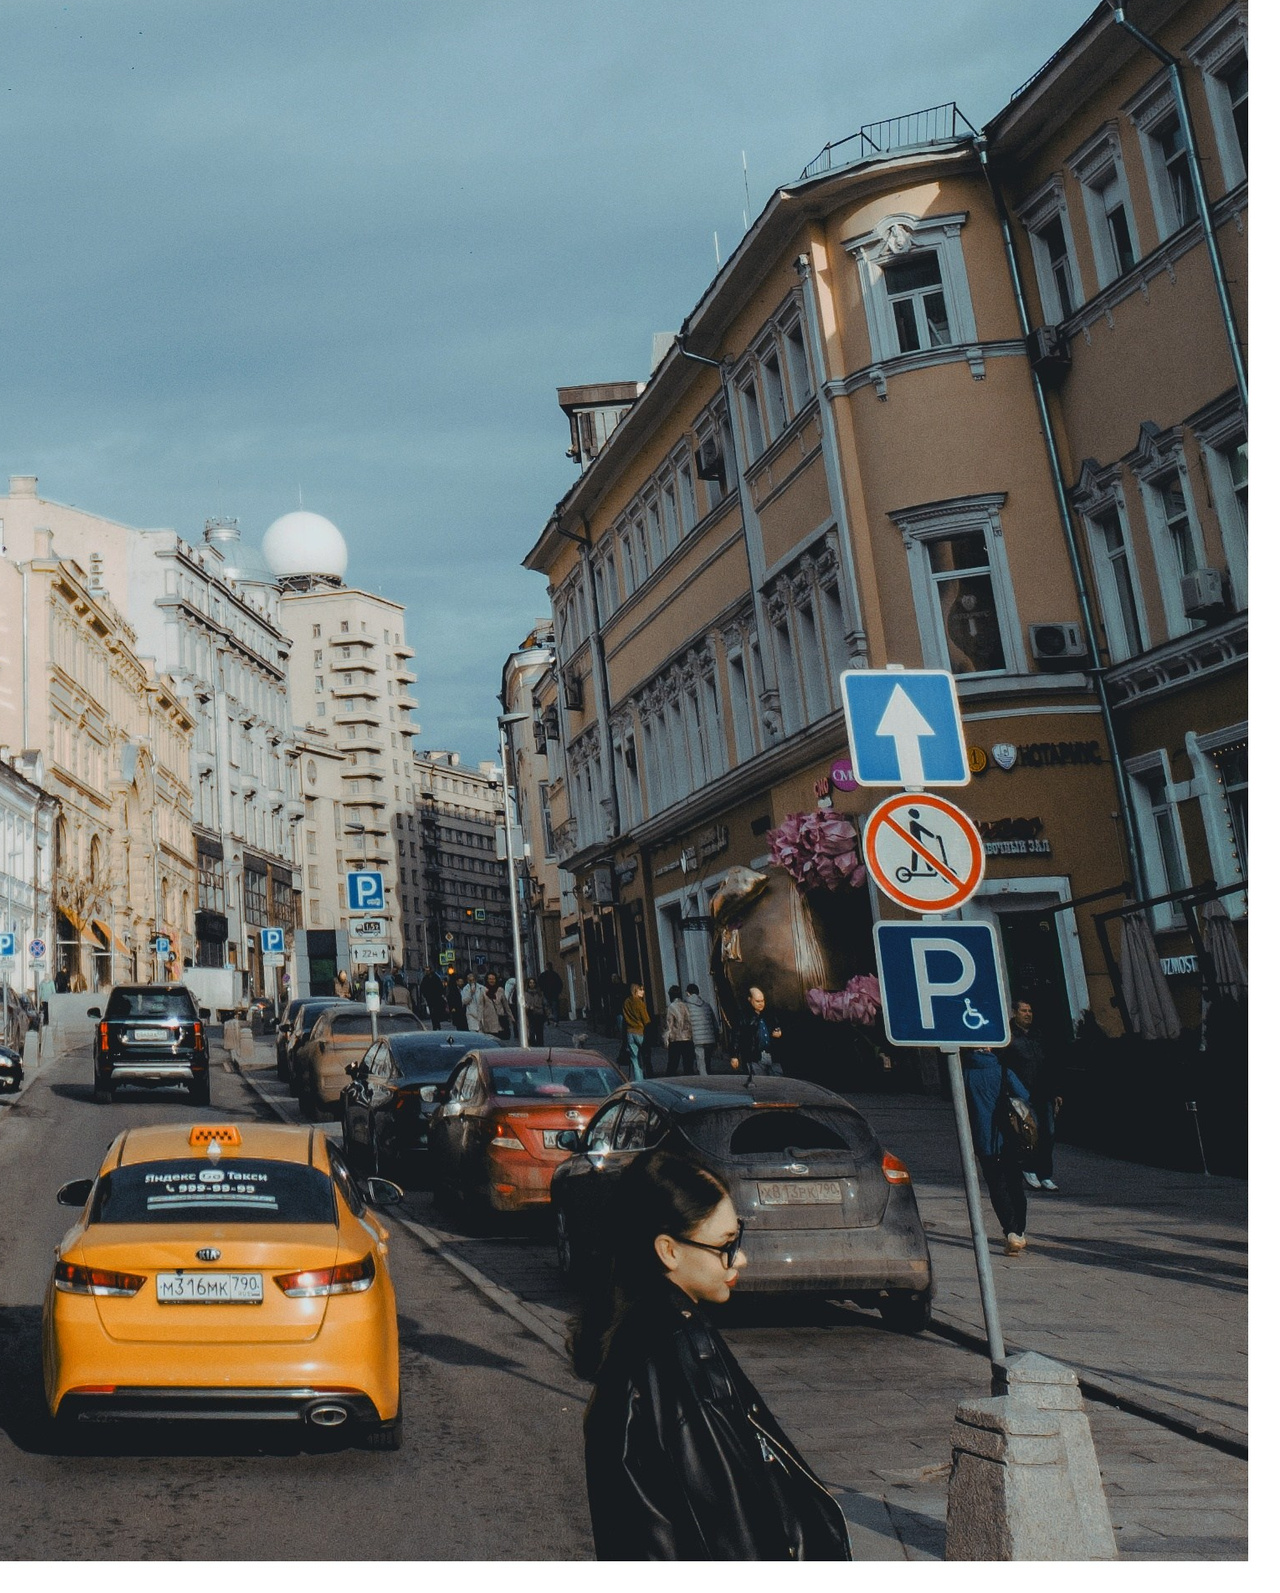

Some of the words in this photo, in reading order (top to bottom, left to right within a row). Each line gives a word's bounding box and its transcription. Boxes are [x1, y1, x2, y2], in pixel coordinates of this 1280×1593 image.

[985, 840, 1027, 855] ВОЧНЫЙ
[1028, 839, 1050, 853] ЗАЛ
[356, 875, 377, 907] P
[159, 940, 168, 951] P
[267, 931, 280, 950] P
[910, 938, 976, 1029] P
[145, 1173, 196, 1183] Яндекс
[227, 1171, 268, 1182] Такси
[178, 1184, 255, 1194] 999-99-99
[199, 1249, 219, 1260] KIA
[163, 1277, 228, 1296] М316МК
[232, 1276, 257, 1291] 790
